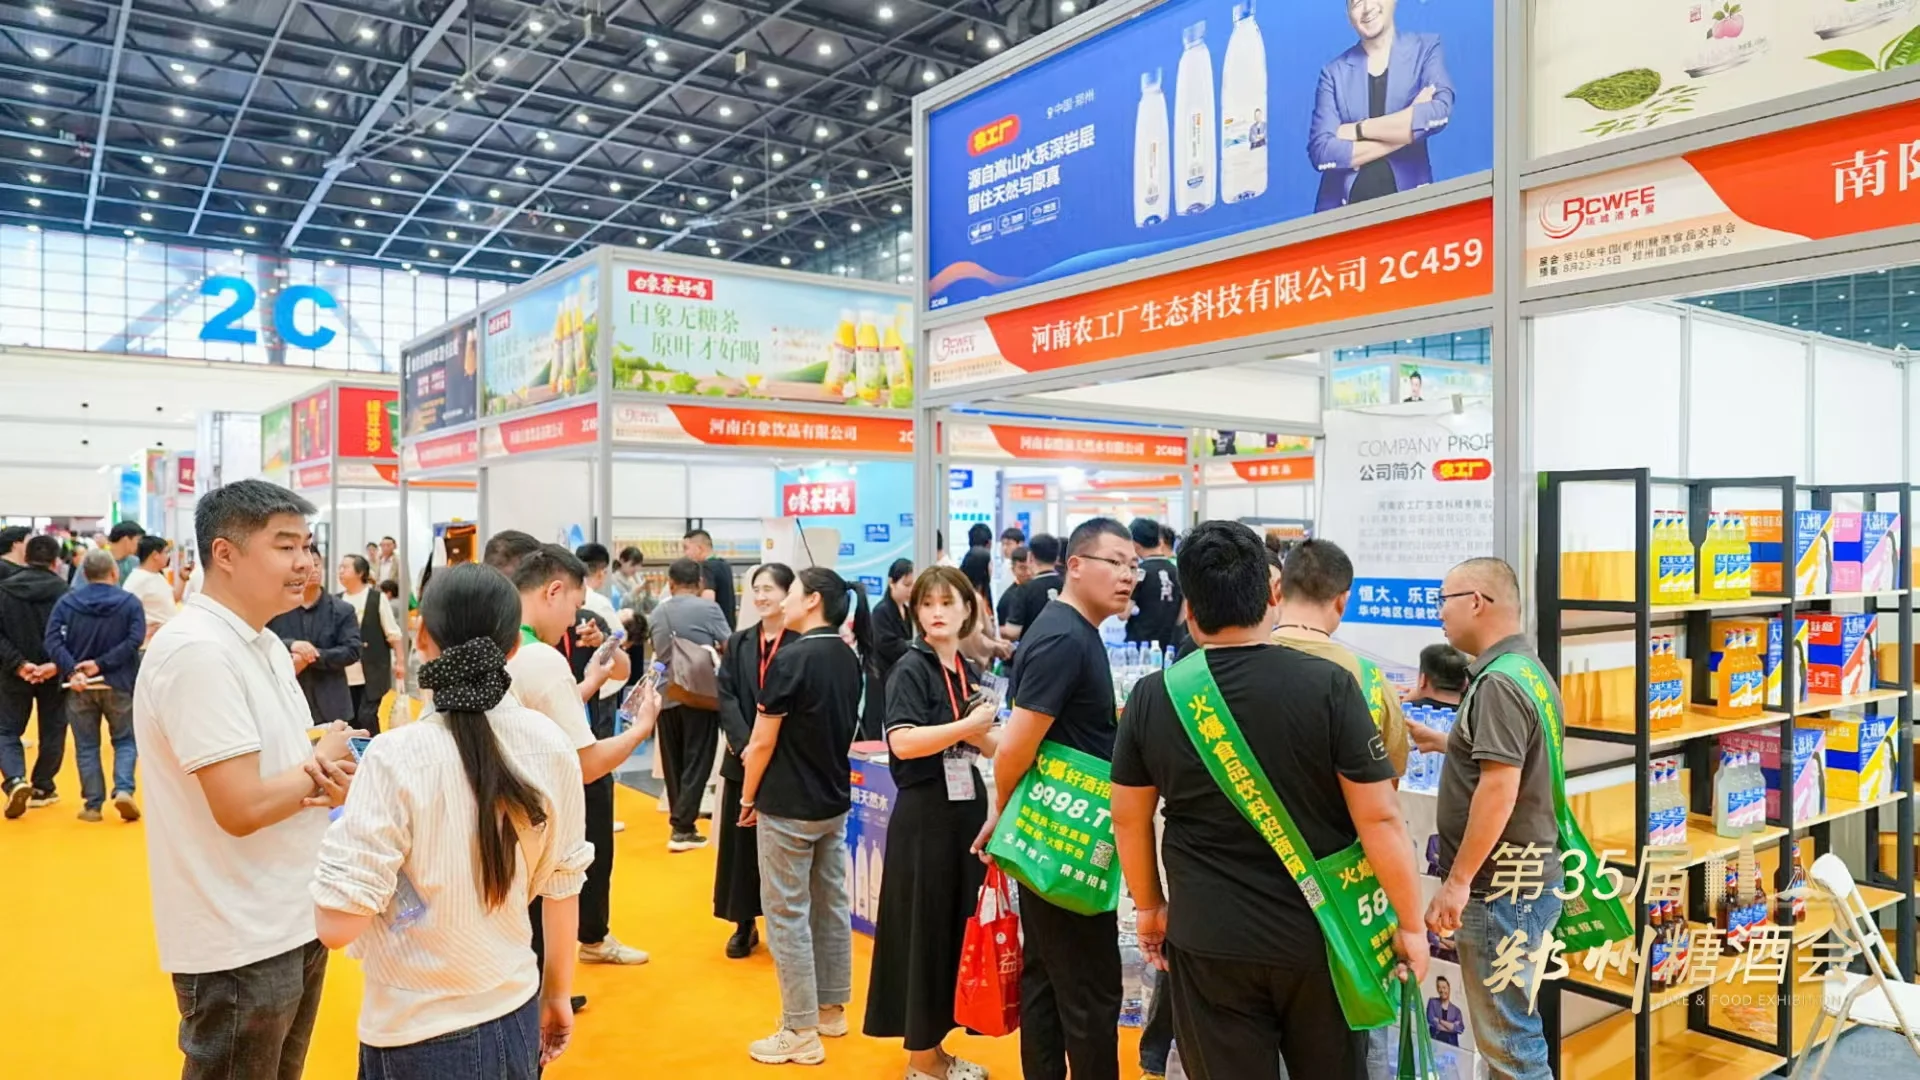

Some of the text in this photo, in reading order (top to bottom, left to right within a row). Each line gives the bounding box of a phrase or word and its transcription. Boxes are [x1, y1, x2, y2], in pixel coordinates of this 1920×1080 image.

[967, 123, 1096, 190] 源自嵩山水系深岩层
[967, 164, 1061, 215] 留住天然与原真
[633, 272, 708, 299] 白象茶好喝
[1030, 237, 1483, 354] 河南农工厂生态科技有限公司 2C459
[199, 275, 338, 350] 2C
[629, 300, 740, 334] 白象无糖茶
[652, 332, 760, 365] 原叶才好喝
[708, 417, 858, 442] 河南白象饮品有限公司
[1358, 438, 1441, 458] COMPANY
[1359, 461, 1426, 482] 公司简介
[1188, 694, 1307, 880] 火爆食品饮料招商网
